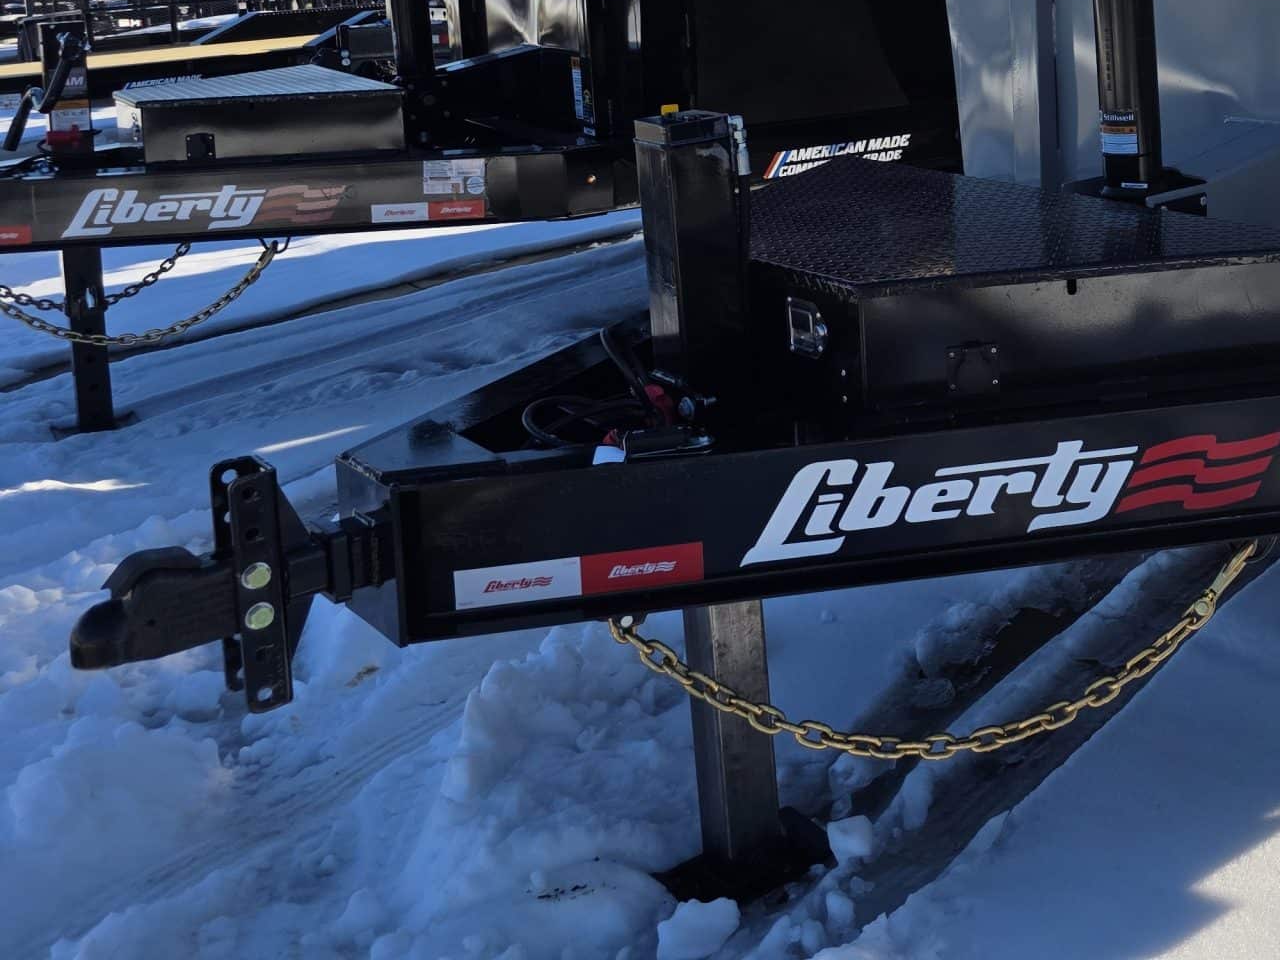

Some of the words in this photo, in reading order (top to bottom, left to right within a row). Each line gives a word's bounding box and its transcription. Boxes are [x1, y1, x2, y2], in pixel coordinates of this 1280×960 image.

[786, 140, 866, 163] AMERICAN
[867, 133, 911, 151] MADE
[61, 185, 268, 238] Liberty
[740, 440, 1138, 567] Liberty
[483, 577, 533, 594] Liberty
[608, 562, 656, 579] Liberty
